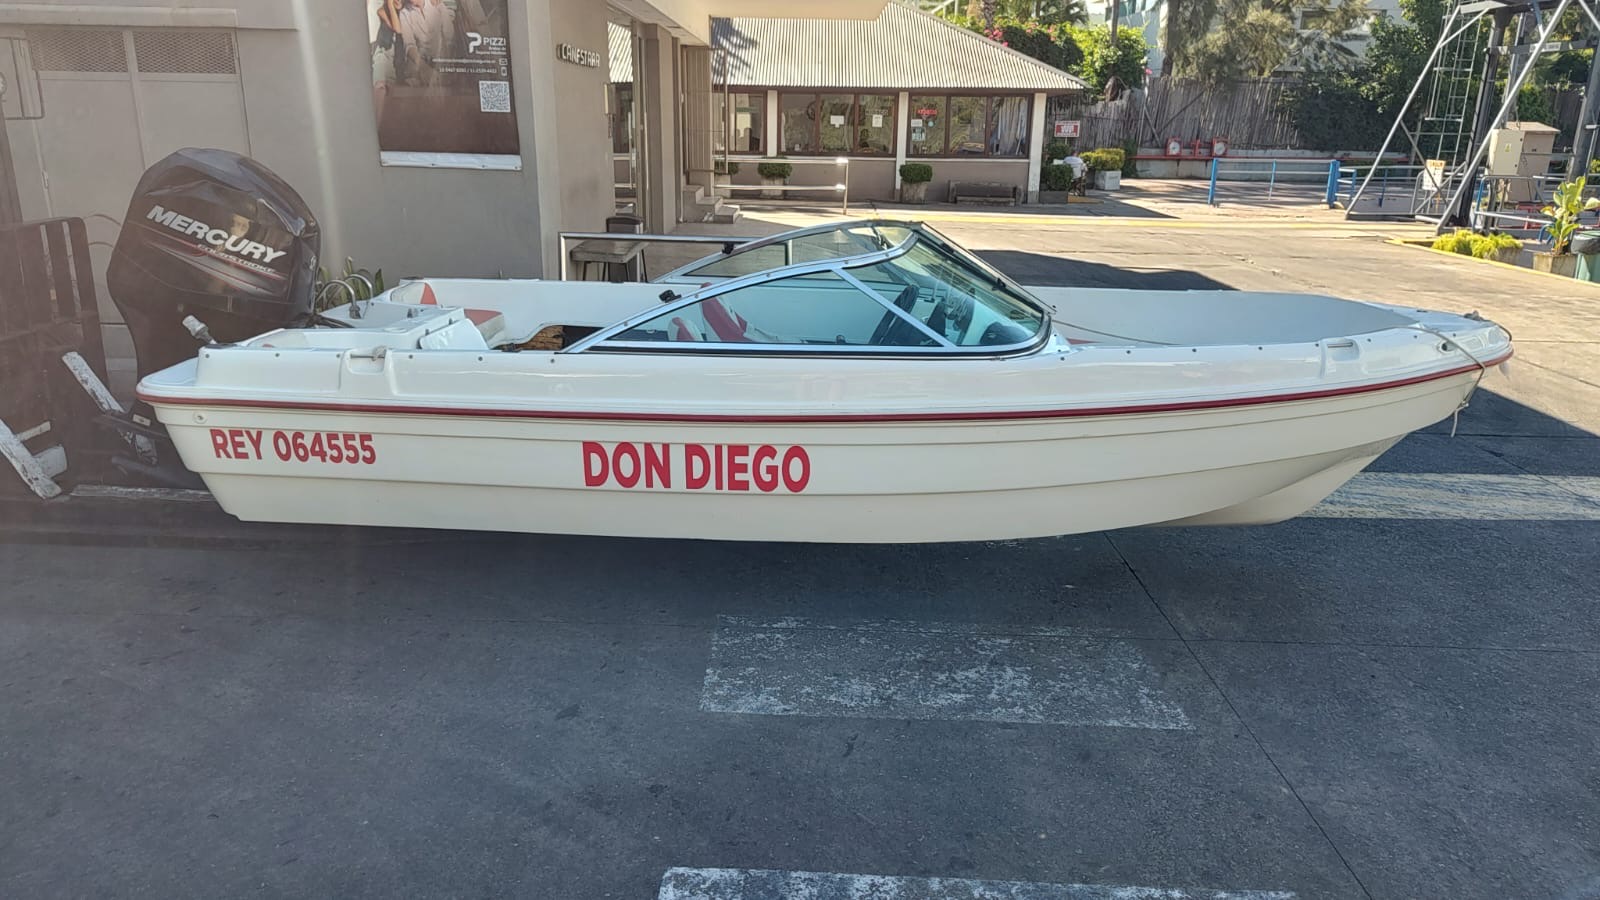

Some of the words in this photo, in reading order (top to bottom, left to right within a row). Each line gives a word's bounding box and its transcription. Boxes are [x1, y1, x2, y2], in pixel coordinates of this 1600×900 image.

[483, 37, 506, 46] PIZZI
[146, 205, 287, 263] MERCURY
[209, 428, 262, 460] REY
[272, 430, 376, 465] 064555
[582, 441, 671, 488] DON
[684, 443, 811, 493] DIEGO
